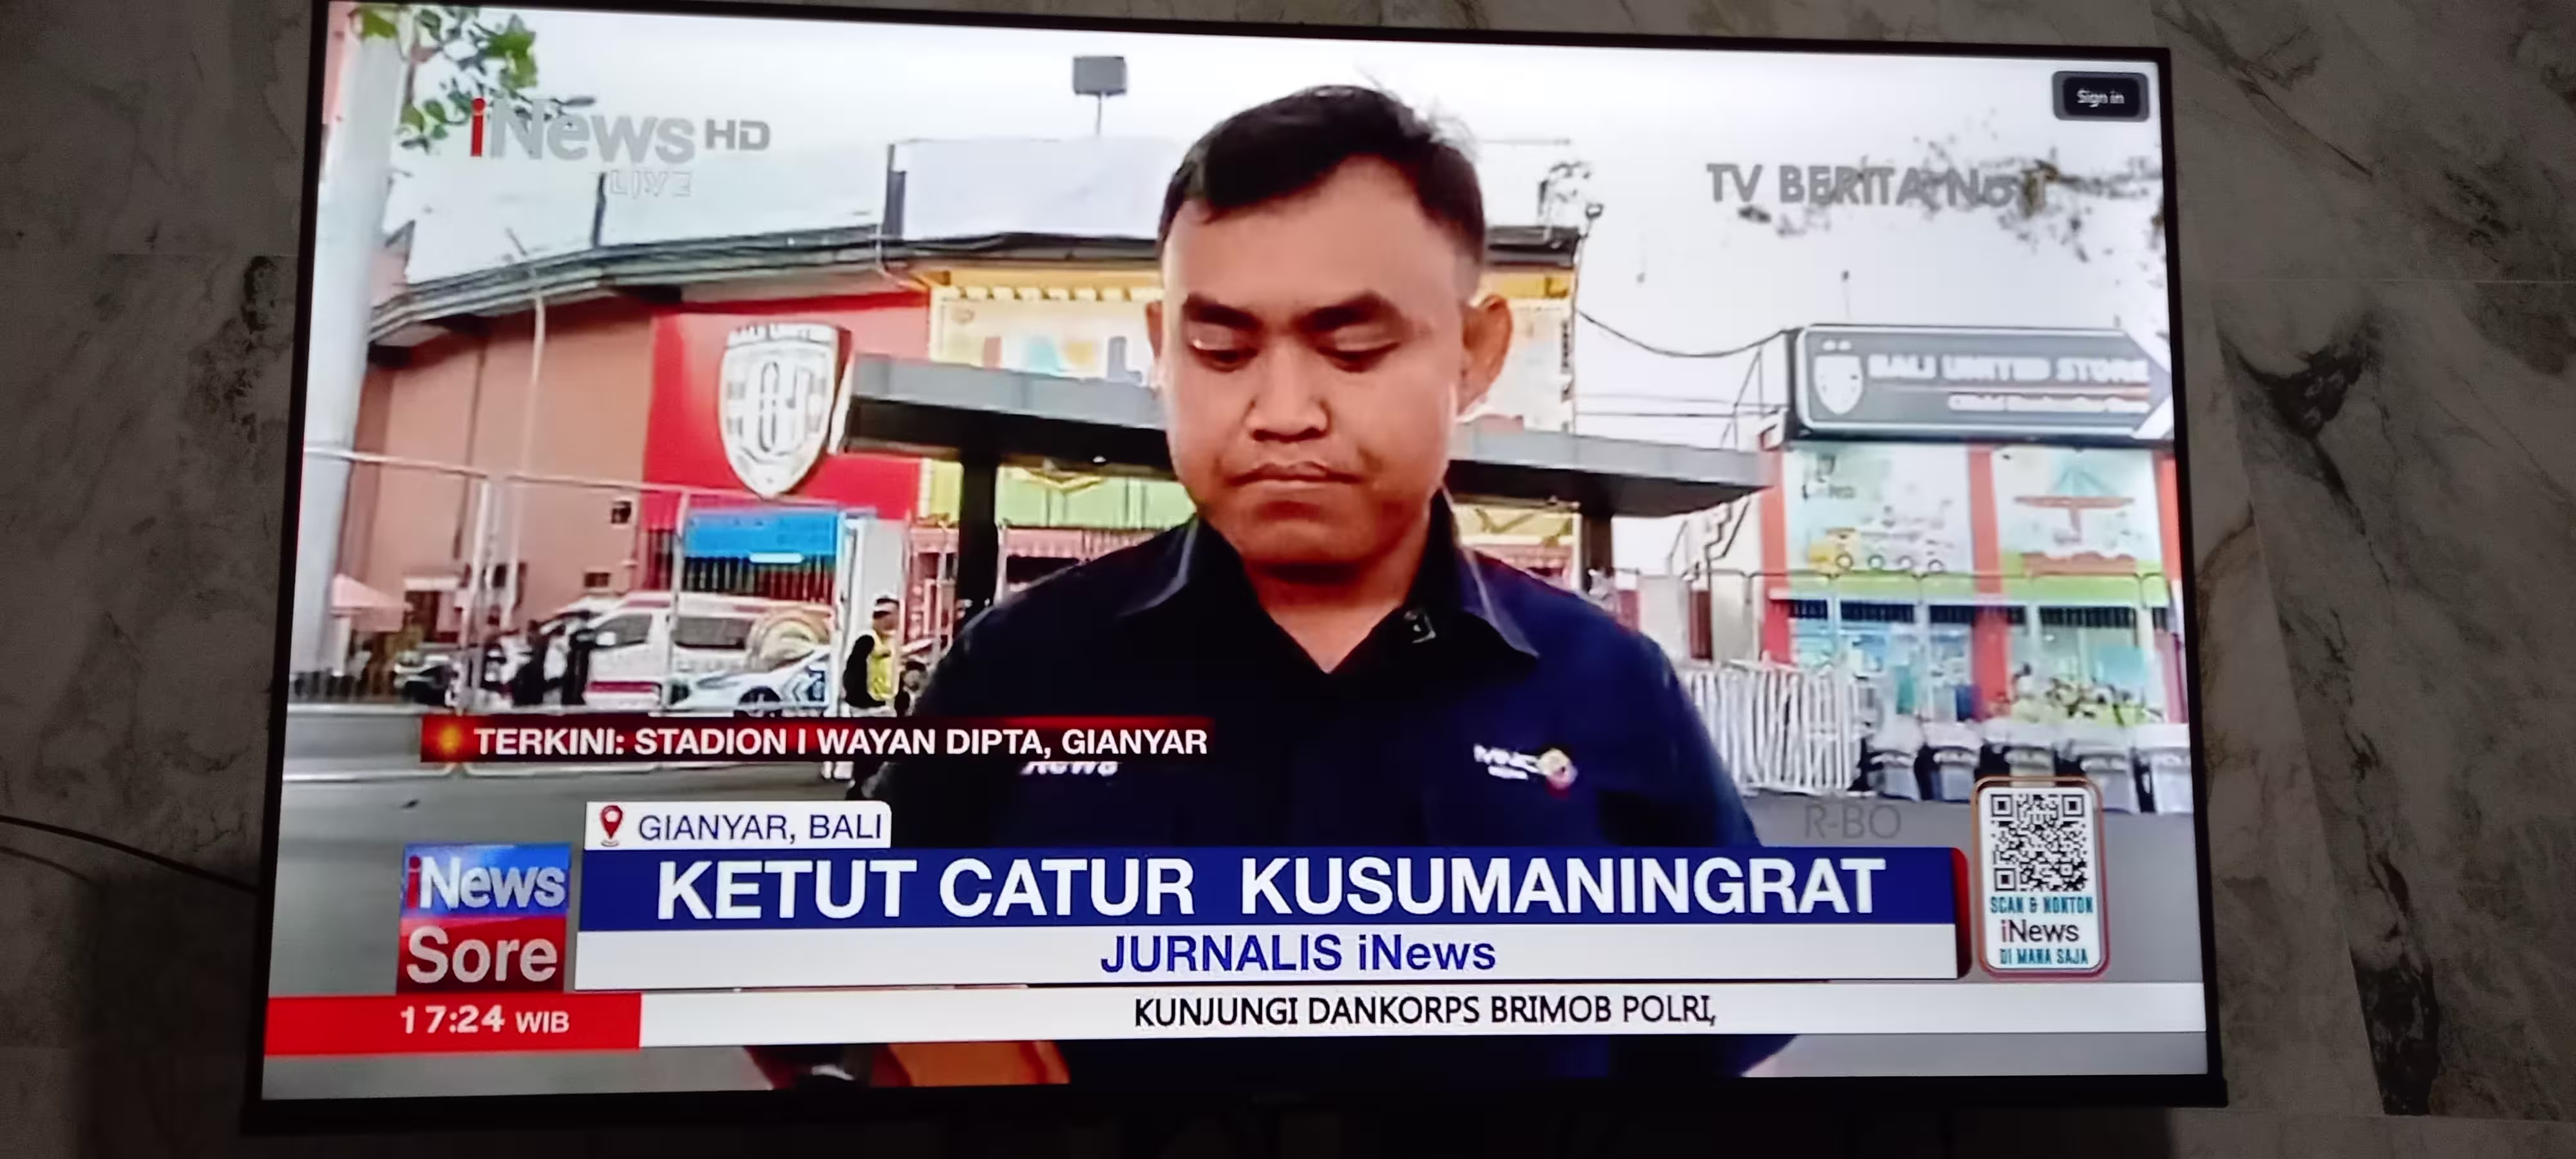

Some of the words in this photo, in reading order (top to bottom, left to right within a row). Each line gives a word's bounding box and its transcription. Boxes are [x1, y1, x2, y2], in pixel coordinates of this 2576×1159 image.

[2076, 88, 2109, 108] Sign
[2110, 89, 2125, 104] in
[470, 98, 696, 164] iNews
[705, 118, 771, 151] HD
[1707, 164, 1763, 203] TV
[1779, 165, 1931, 206] BERITA
[473, 728, 625, 756] TERKINI:
[634, 728, 786, 755] STADION
[798, 729, 806, 755] I
[816, 728, 936, 755] WAYAN
[946, 728, 1052, 759] DIPTA,
[1061, 728, 1208, 755] GIANYAR
[638, 814, 796, 845] GIANYAR,
[809, 813, 882, 840] BALI
[1804, 804, 1902, 840] R-BO
[406, 855, 566, 909] iNews
[657, 858, 917, 921] KETUT
[939, 856, 1195, 918] CATUR
[1241, 856, 1886, 917] KUSUMANINGRAT
[1990, 896, 2023, 913] SCAN
[2043, 896, 2093, 913] NONTON
[2001, 919, 2079, 943] iNews
[406, 925, 558, 983] Sore
[1101, 934, 1343, 974] JURNALIS
[1358, 932, 1496, 972] iNews
[2057, 948, 2088, 965] SAJA
[401, 1004, 505, 1034] 17:24
[515, 1011, 570, 1033] WIB
[1134, 997, 1298, 1028] KUNJUNGI
[1309, 995, 1480, 1026] DANKORPS
[1491, 995, 1613, 1025] BRIMOB
[1623, 995, 1717, 1027] POLRI,
